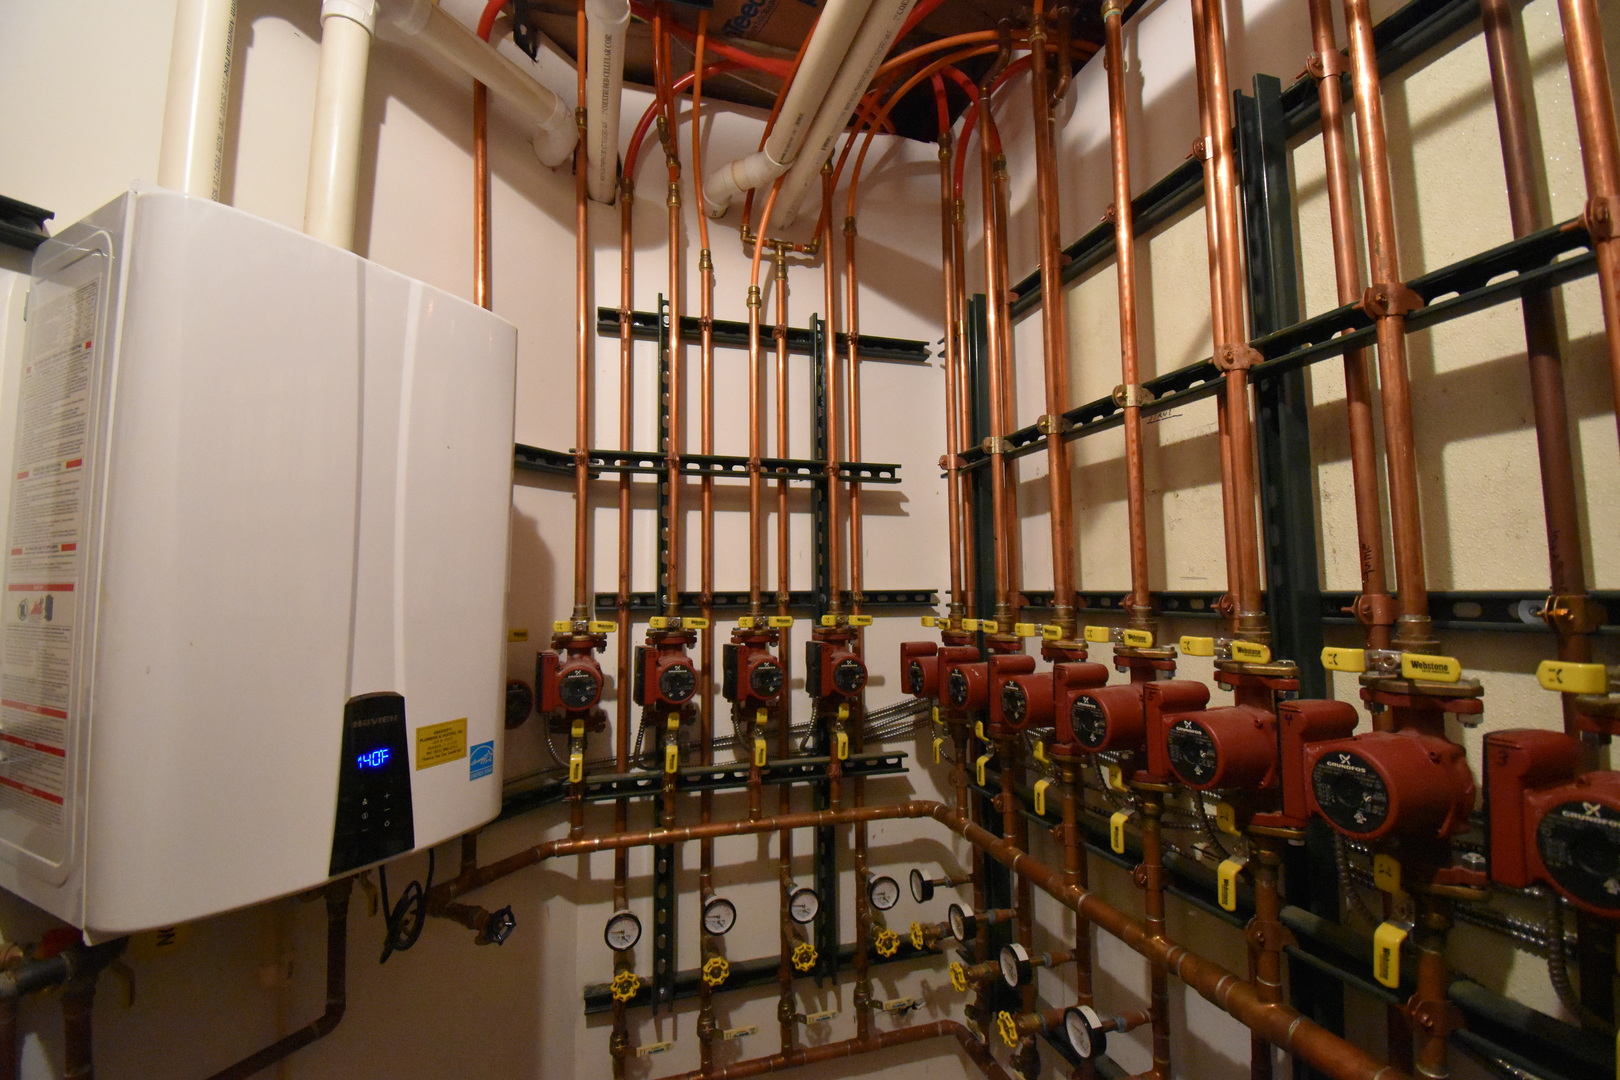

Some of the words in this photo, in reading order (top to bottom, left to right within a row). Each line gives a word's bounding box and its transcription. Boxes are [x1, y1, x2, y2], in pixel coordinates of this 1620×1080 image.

[225, 17, 236, 57] American
[223, 57, 232, 77] Pipe
[1410, 660, 1448, 672] Webstone
[1326, 761, 1366, 773] GRUNDFOS
